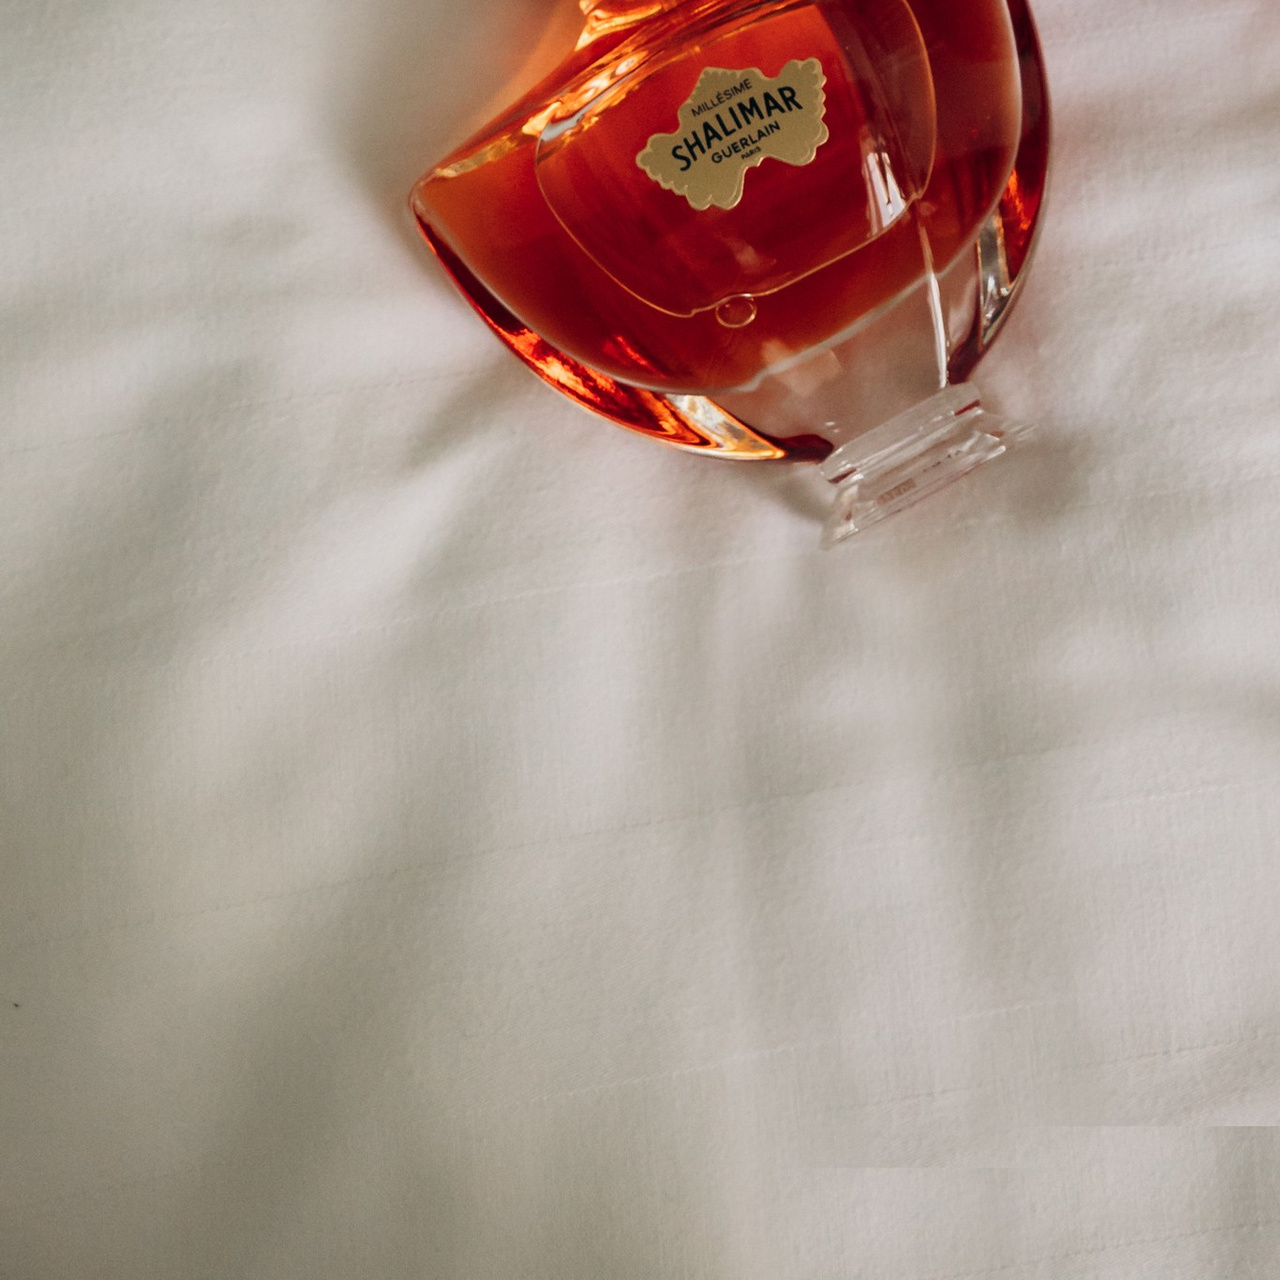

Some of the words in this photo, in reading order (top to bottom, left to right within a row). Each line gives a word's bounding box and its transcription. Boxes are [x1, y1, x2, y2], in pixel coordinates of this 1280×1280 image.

[691, 78, 753, 117] MILLÉSIME
[672, 86, 803, 171] SHALIMAR
[711, 120, 781, 163] GUERLAIN
[741, 146, 762, 160] PARIS
